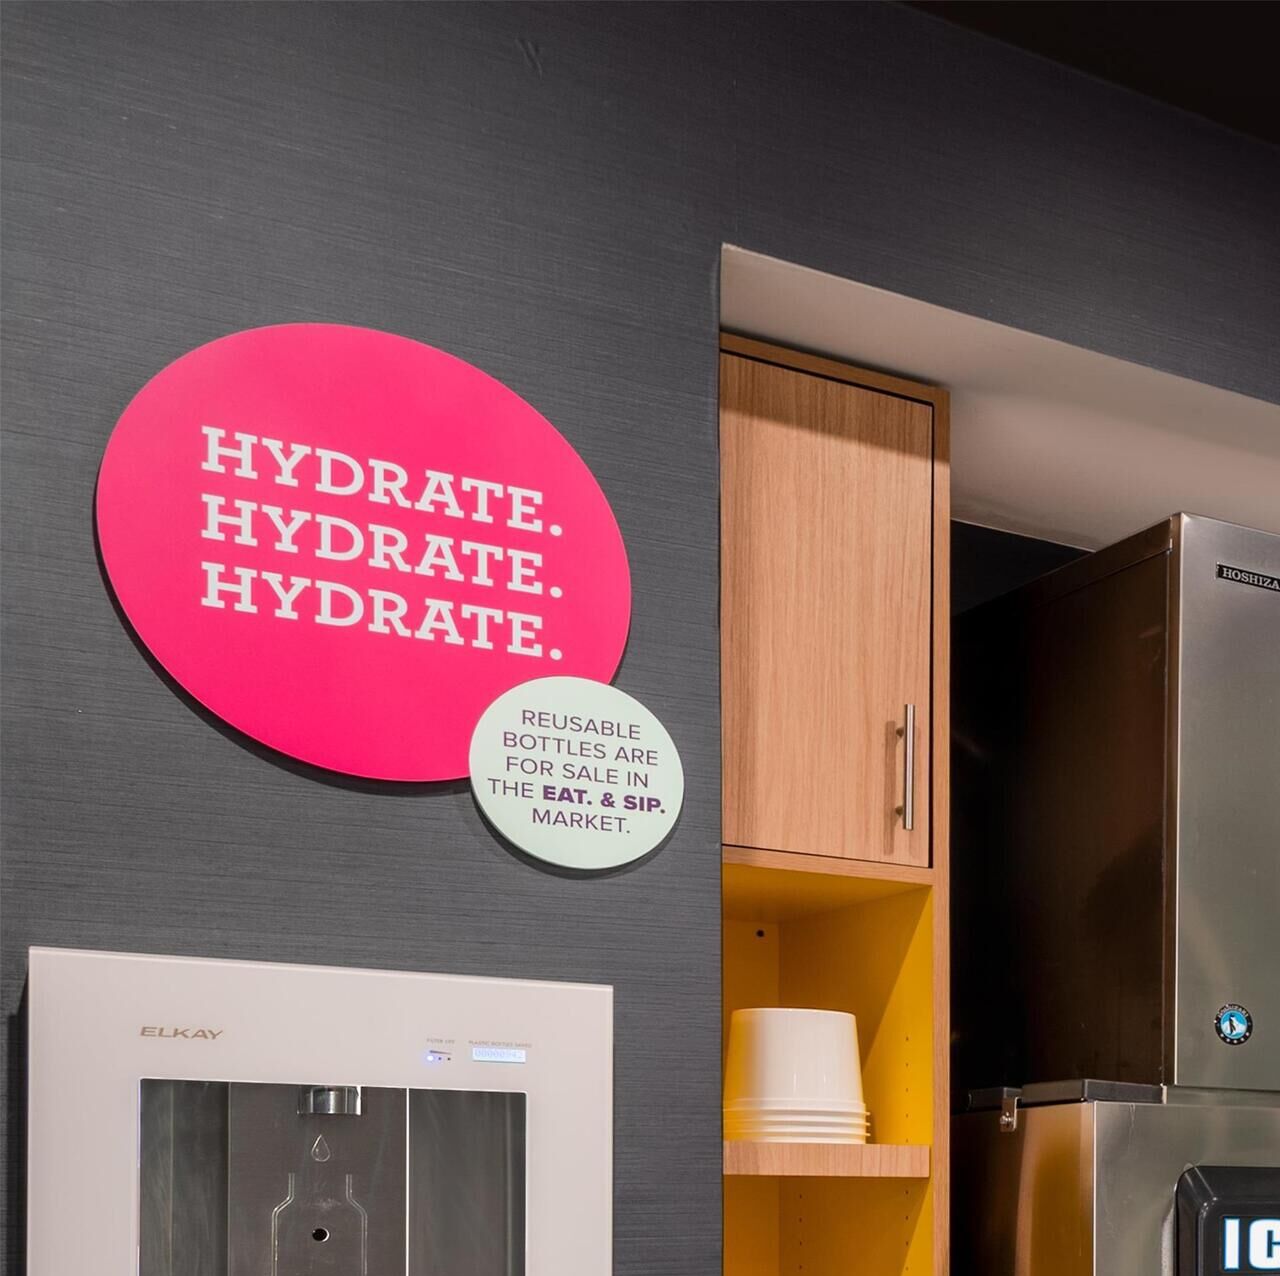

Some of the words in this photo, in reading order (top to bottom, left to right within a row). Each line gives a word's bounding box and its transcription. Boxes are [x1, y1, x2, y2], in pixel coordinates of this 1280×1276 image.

[201, 425, 563, 537] HYDRATE.
[201, 493, 563, 598] HYDRATE.
[201, 561, 563, 661] HYDRATE.
[521, 709, 641, 740] REUSABLE
[502, 731, 607, 760] BOTTLES
[614, 746, 659, 767] ARE
[506, 756, 554, 777] FOR
[561, 763, 619, 785] SALE
[627, 770, 649, 789] IN
[487, 777, 534, 799] THE
[542, 784, 593, 806] EAT.
[600, 791, 616, 809] &
[623, 795, 666, 814] SIP.
[531, 807, 631, 834] MARKET.
[140, 1026, 223, 1040] ELKAY
